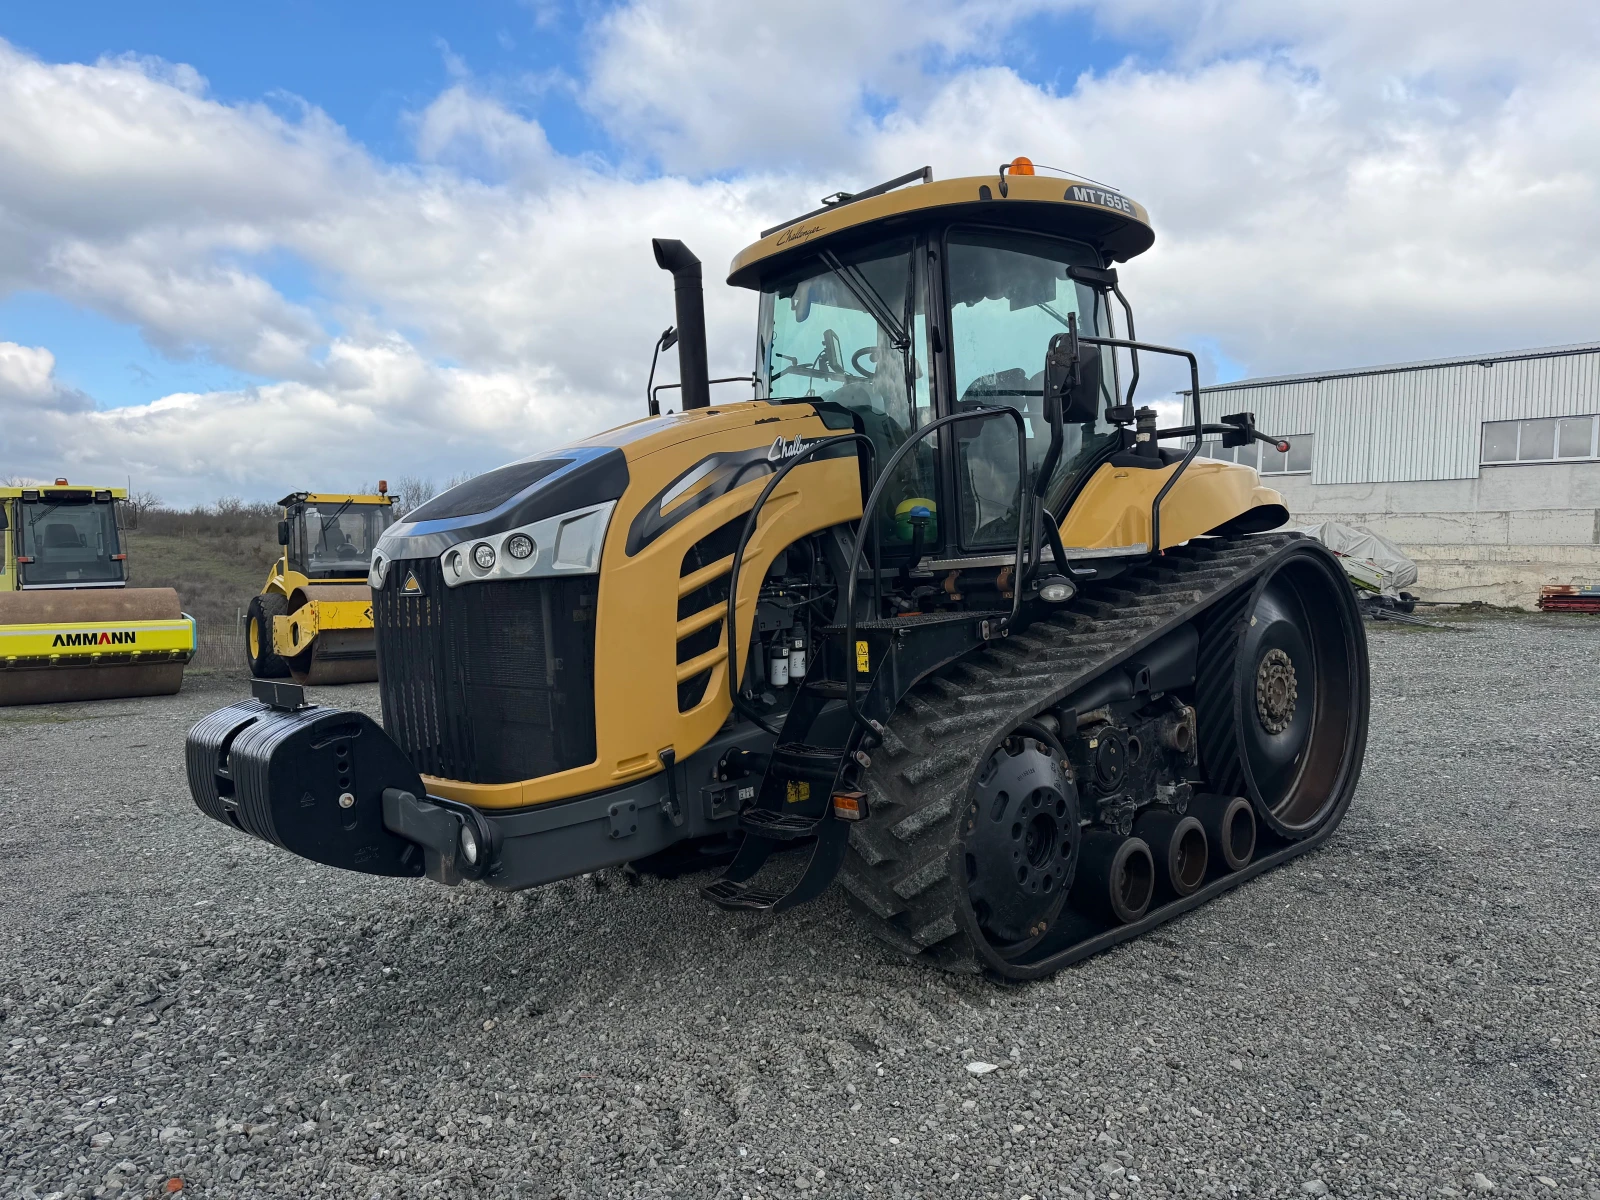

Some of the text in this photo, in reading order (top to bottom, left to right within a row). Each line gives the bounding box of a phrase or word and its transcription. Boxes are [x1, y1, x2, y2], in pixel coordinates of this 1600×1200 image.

[776, 225, 827, 246] Challenger
[767, 434, 826, 461] Challen
[52, 631, 136, 647] AMMANN
